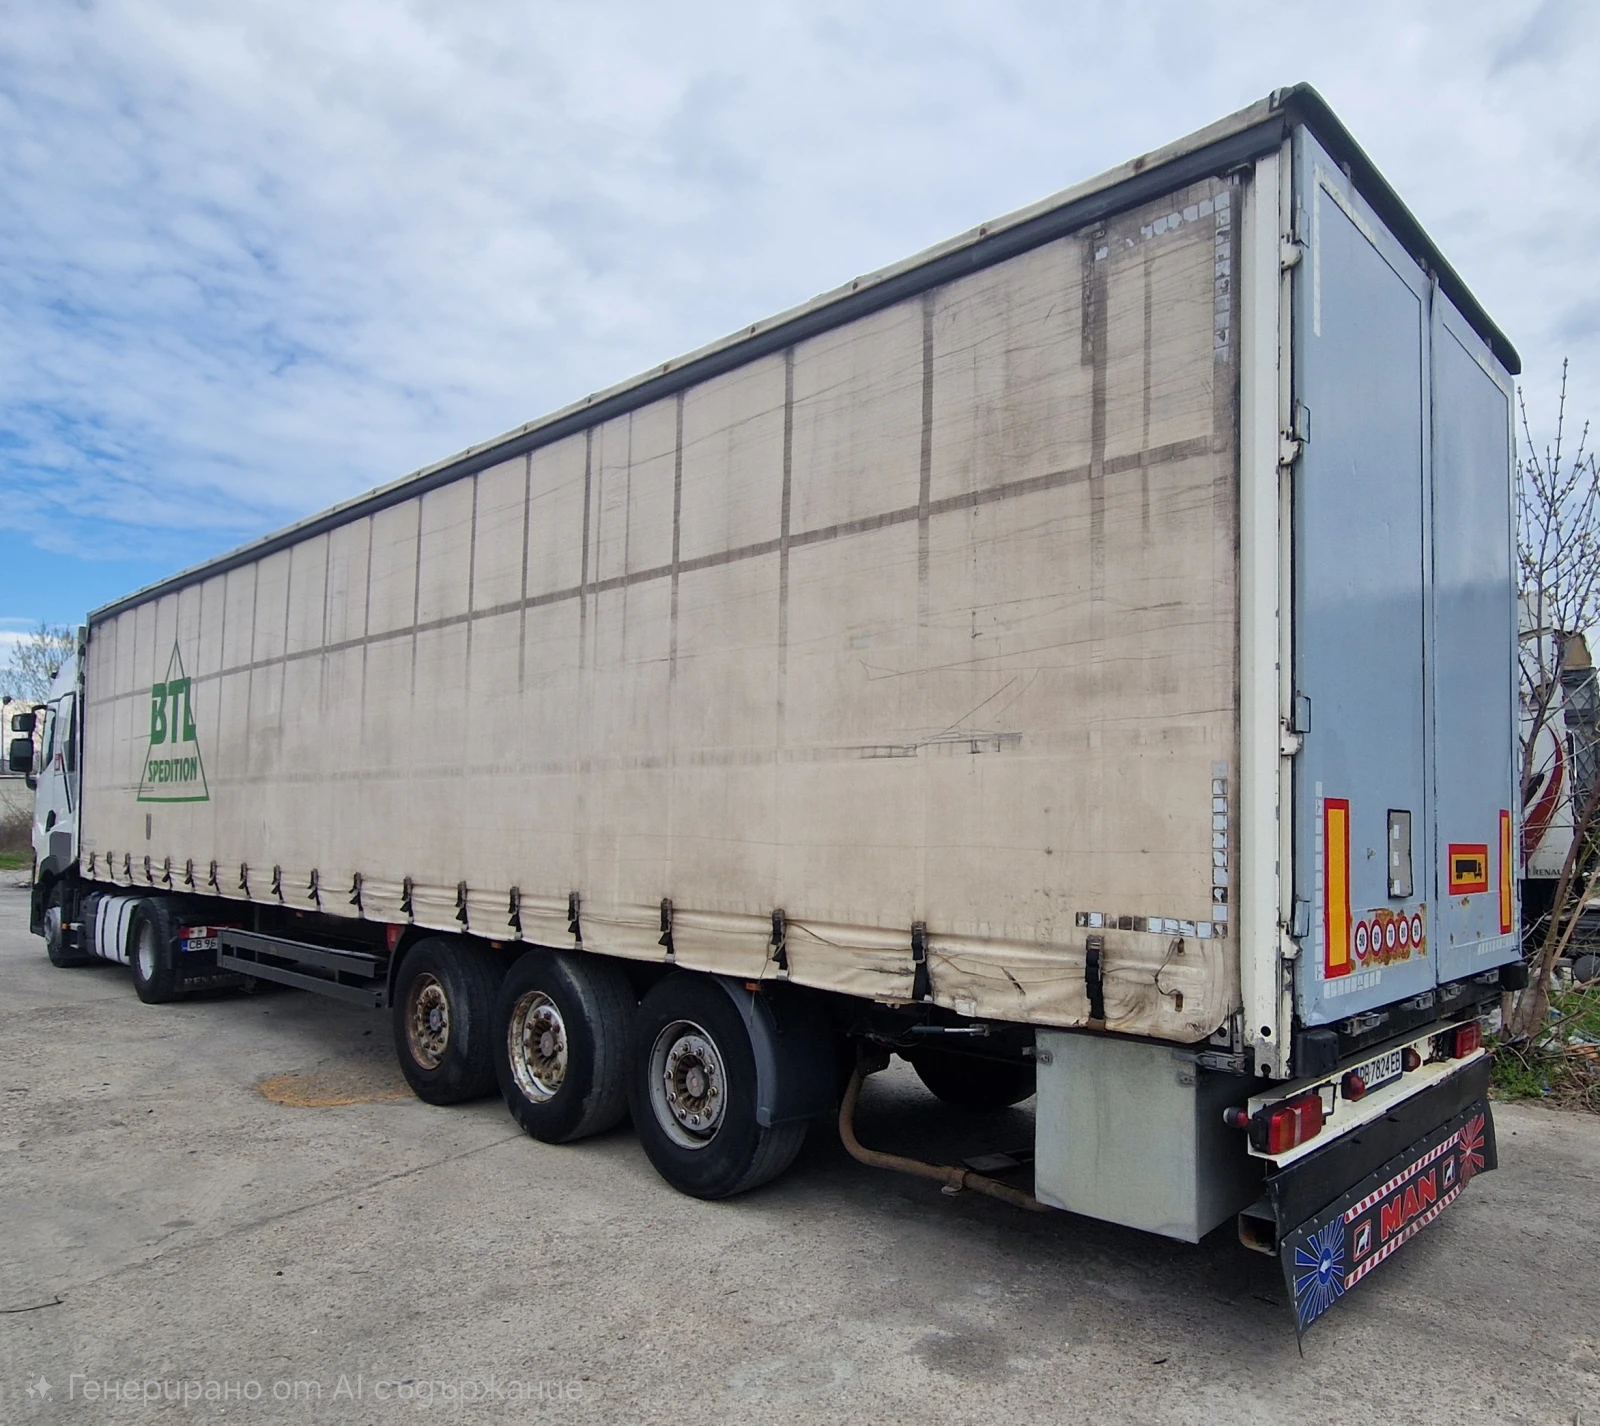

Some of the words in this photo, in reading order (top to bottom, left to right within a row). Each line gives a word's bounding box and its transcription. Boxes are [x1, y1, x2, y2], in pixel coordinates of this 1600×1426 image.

[150, 676, 196, 745] BTL
[148, 756, 197, 783] SPEDITION
[189, 939, 202, 949] CB
[1381, 1168, 1437, 1242] MAN
